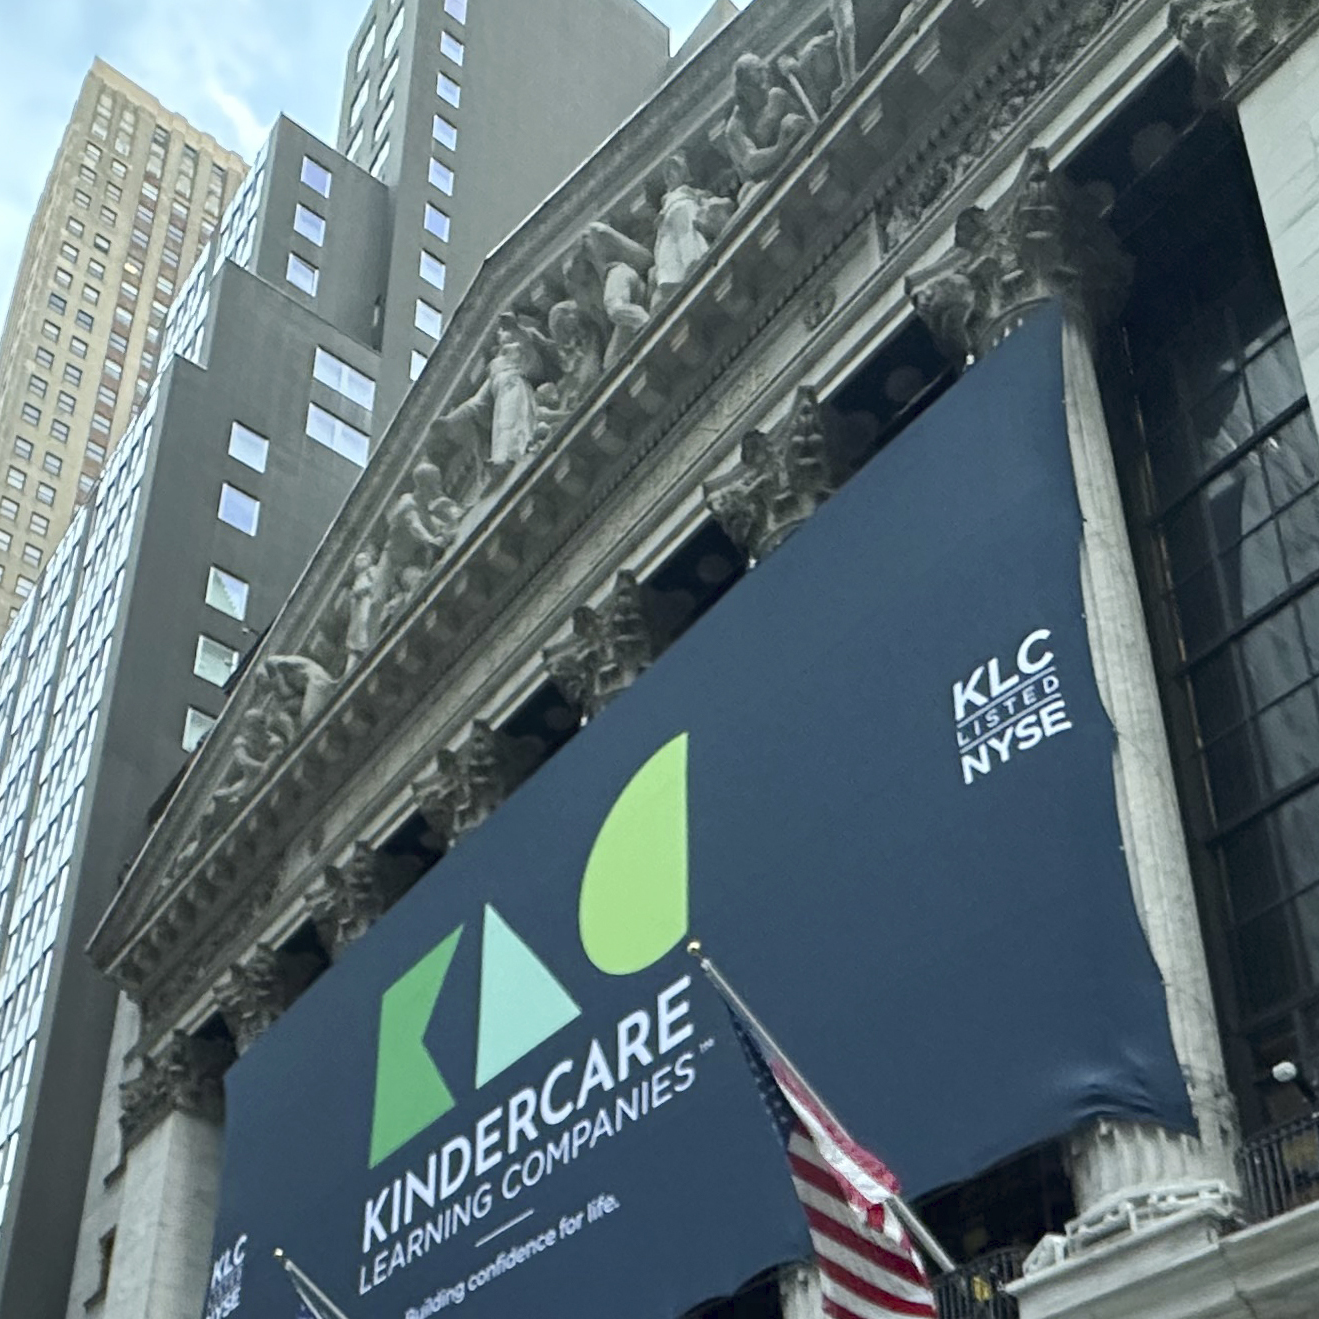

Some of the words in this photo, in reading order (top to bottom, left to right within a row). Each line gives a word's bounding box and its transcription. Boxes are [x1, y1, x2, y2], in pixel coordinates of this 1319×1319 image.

[952, 628, 1054, 721] KLC
[956, 676, 1060, 748] LISTED
[961, 699, 1072, 785] NYSE
[363, 975, 694, 1253] KINDERCARE
[359, 1183, 492, 1296] LEARNING
[501, 1052, 696, 1200] COMPANIES
[210, 1233, 248, 1289] KLC
[467, 1228, 556, 1292] confidence
[559, 1210, 585, 1239] for
[587, 1193, 620, 1223] life.
